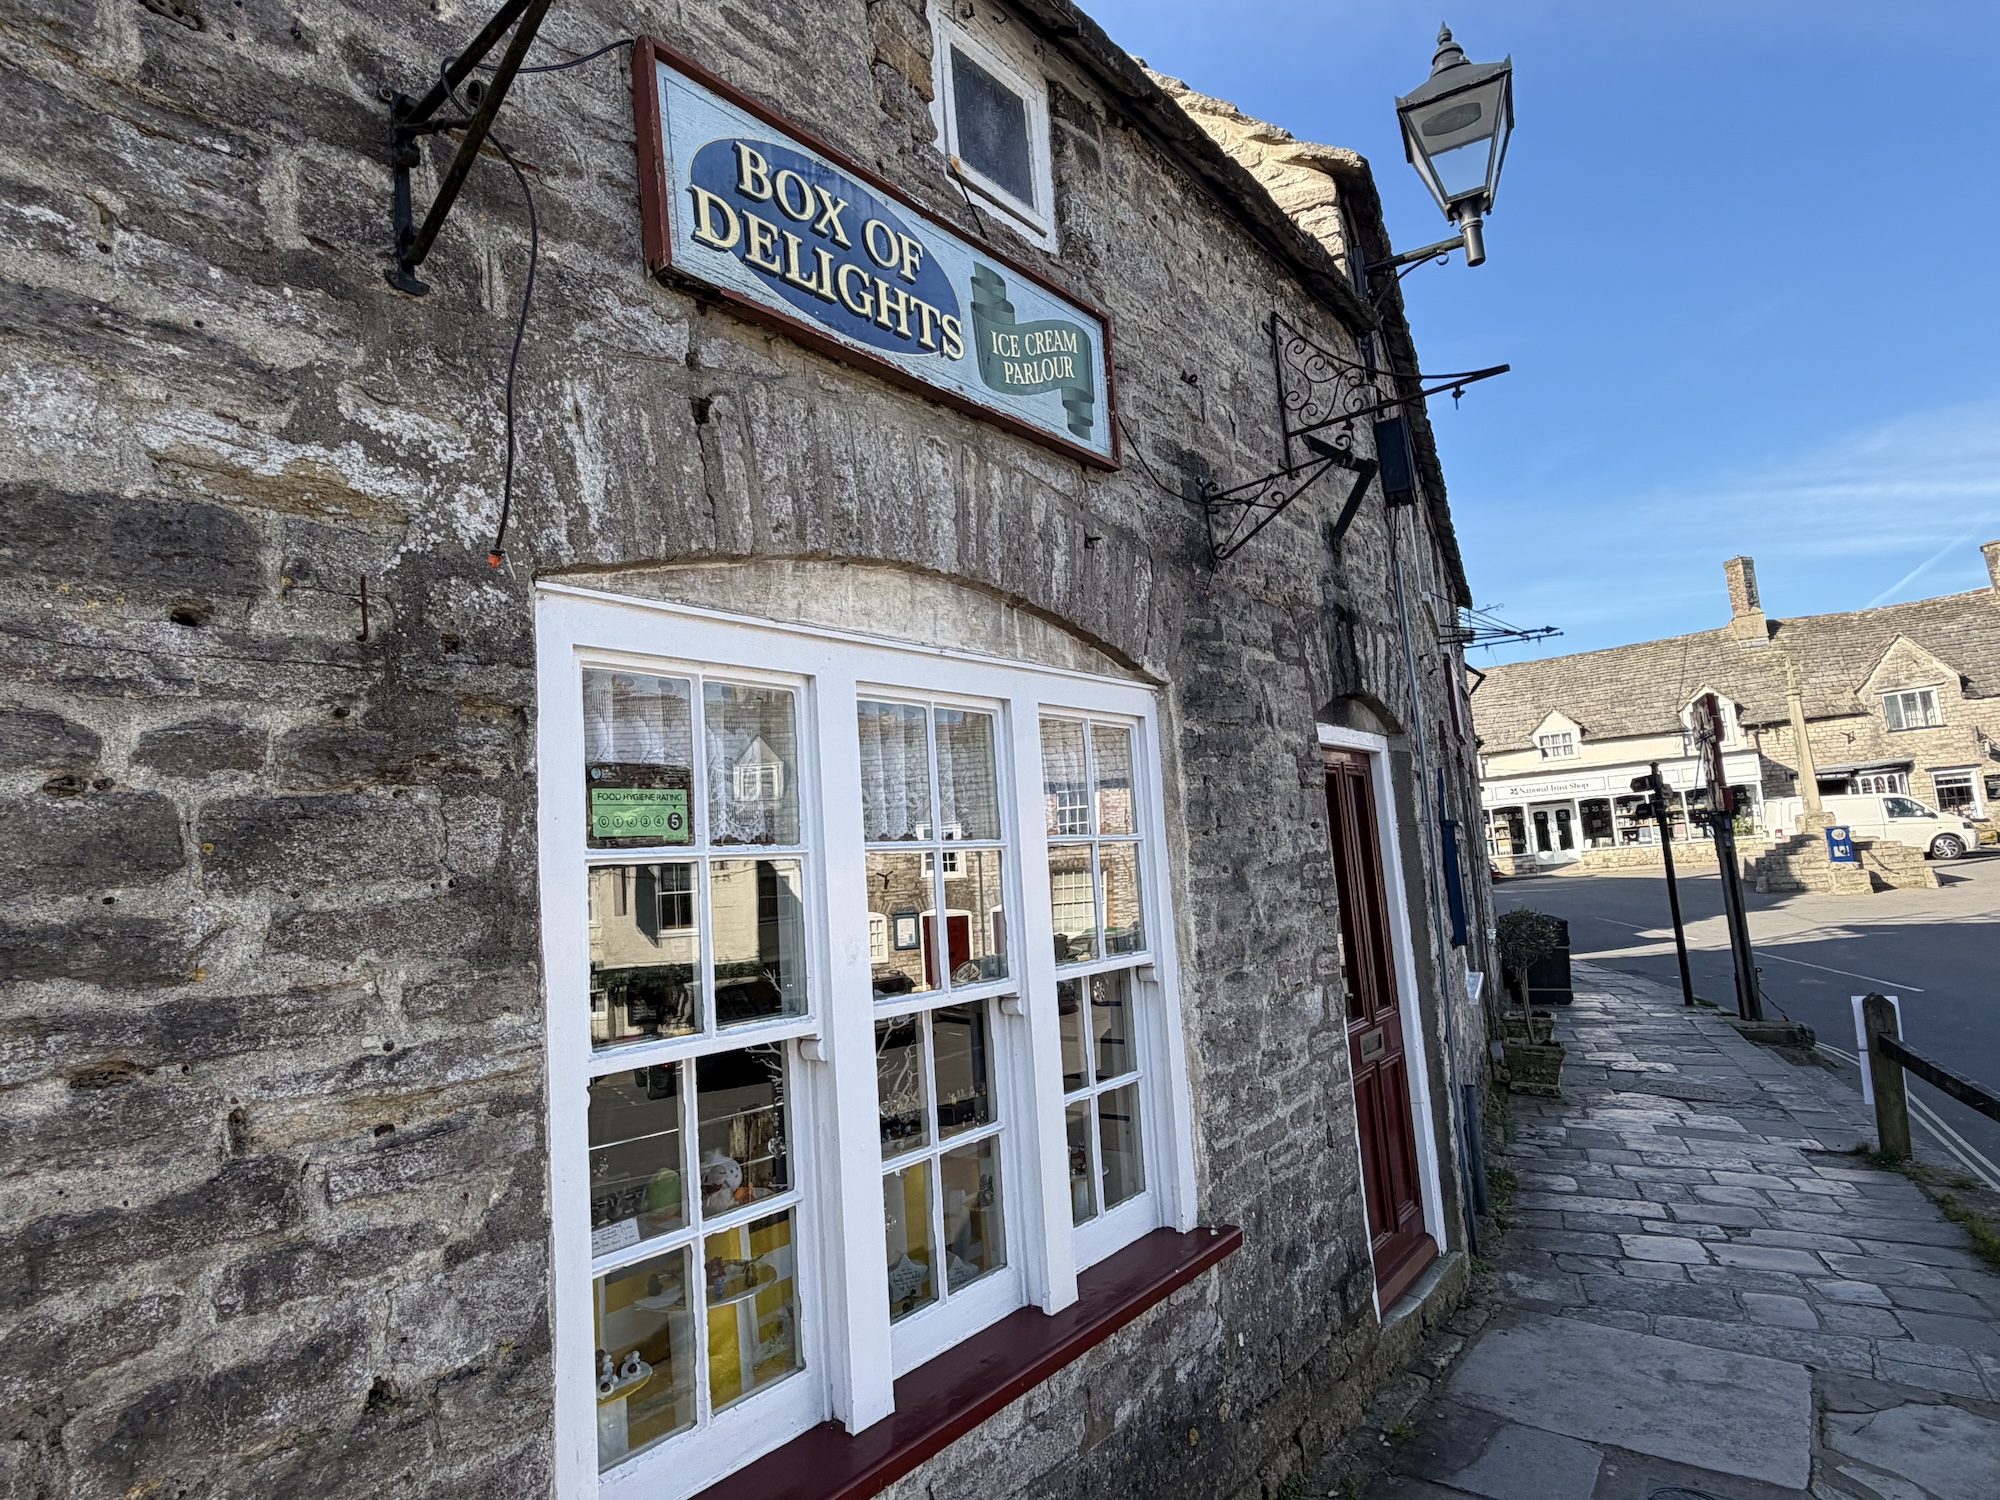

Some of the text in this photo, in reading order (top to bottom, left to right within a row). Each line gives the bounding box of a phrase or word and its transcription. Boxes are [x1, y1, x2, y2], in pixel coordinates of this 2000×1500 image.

[732, 140, 924, 283] BOX OF
[691, 184, 965, 360] DELIGHTS
[991, 330, 1078, 357] ICE CREAM
[1003, 356, 1075, 384] PARLOUR
[597, 792, 682, 801] FOOD HYGIENE RATING
[1519, 785, 1549, 794] National
[1569, 782, 1589, 790] Shop
[671, 814, 680, 828] 5
